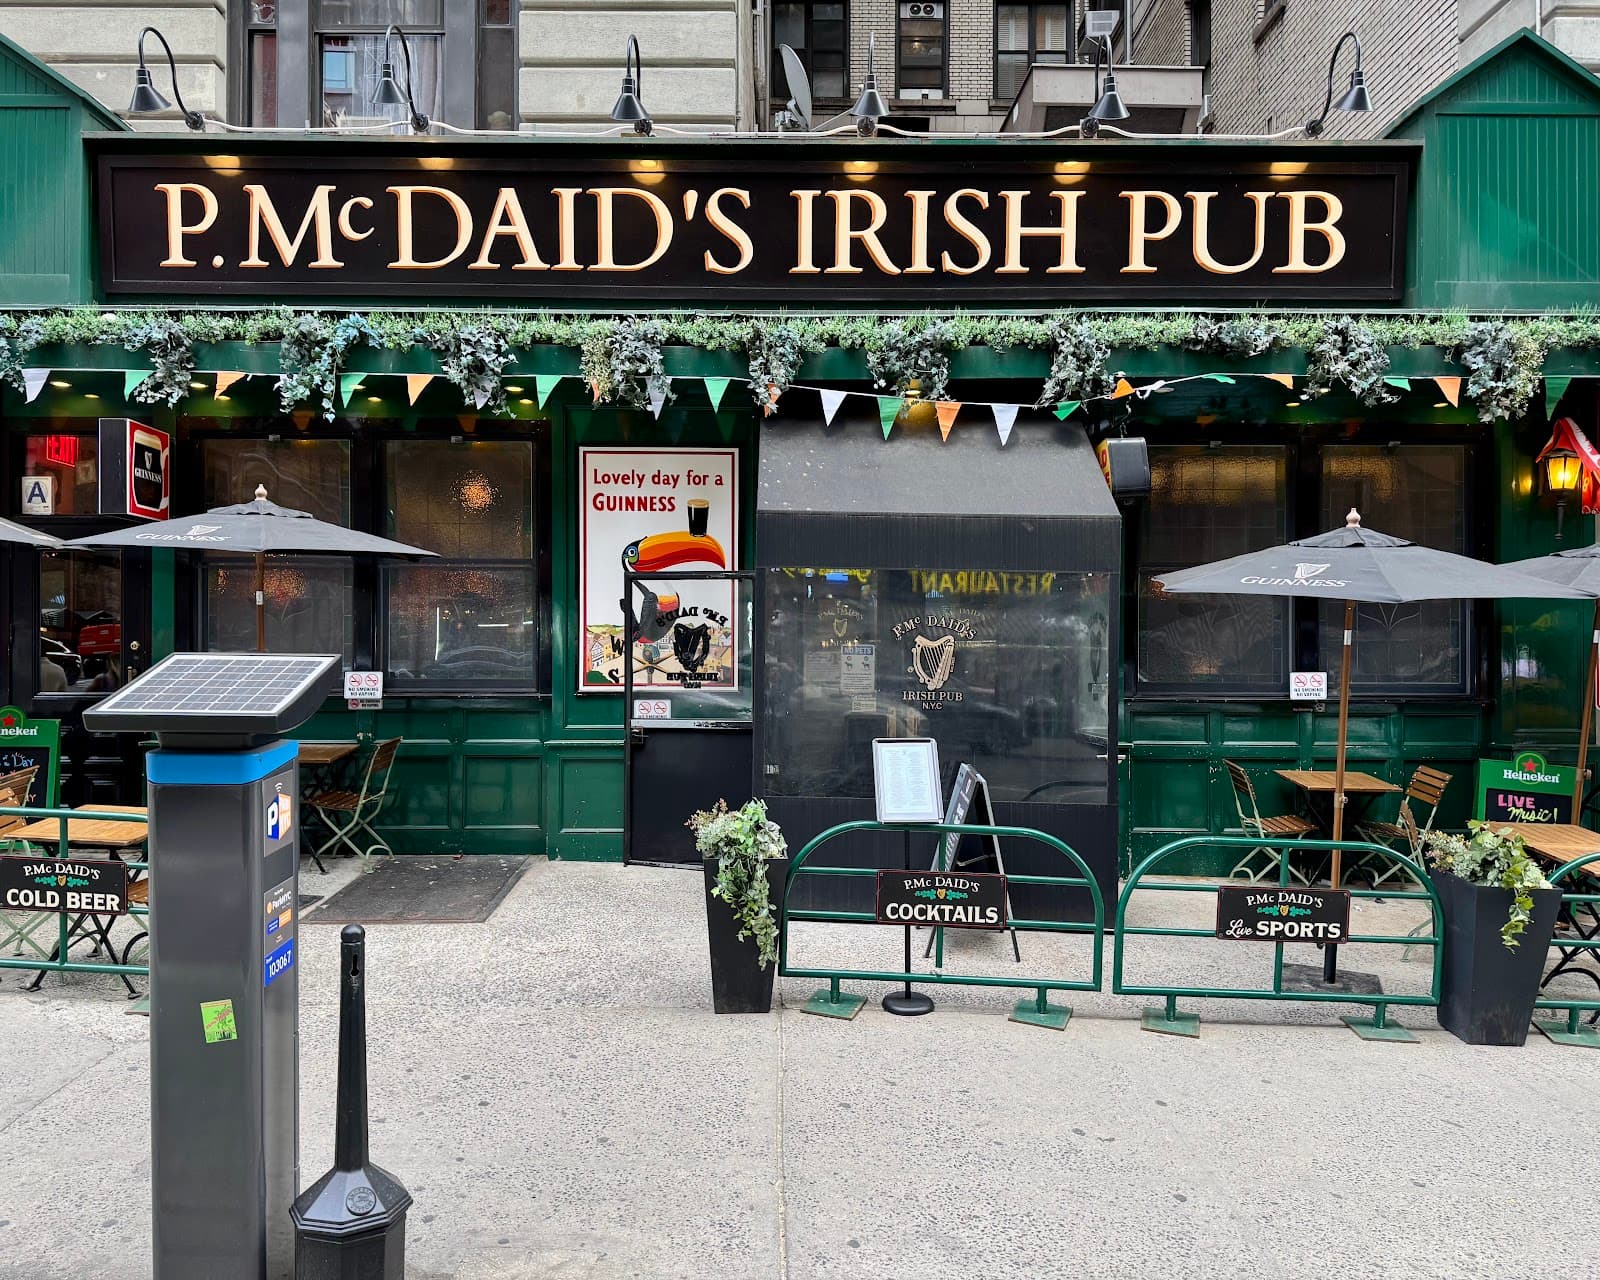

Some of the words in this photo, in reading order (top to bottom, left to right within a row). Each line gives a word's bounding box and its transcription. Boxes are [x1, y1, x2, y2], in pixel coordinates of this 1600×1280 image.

[788, 188, 1087, 275] IRISH
[1118, 190, 1347, 275] PUB
[134, 467, 162, 484] GUINNESS
[593, 468, 646, 488] Lovely
[652, 469, 680, 489] day
[686, 469, 709, 486] for
[714, 474, 724, 486] a
[27, 481, 47, 504] A
[592, 492, 676, 512] GUINNESS
[135, 533, 225, 542] GUINNESS
[1240, 576, 1347, 587] GUINNESS
[927, 615, 977, 640] DAID'S
[855, 646, 872, 654] PETS
[902, 690, 937, 701] IRISH
[939, 690, 963, 701] PUB
[0, 727, 38, 736] neken
[1503, 769, 1560, 783] Heineken
[1497, 794, 1536, 809] LIVE
[267, 801, 279, 836] P
[54, 862, 101, 880] DAID'S
[935, 876, 980, 893] DAID'S
[6, 888, 60, 908] COLD
[66, 891, 120, 911] BEER
[1278, 892, 1324, 908] DAID'S
[885, 903, 999, 924] COCKTAILS
[1225, 918, 1254, 938] Live
[1255, 920, 1341, 939] SPORTS
[269, 950, 292, 978] 103067
